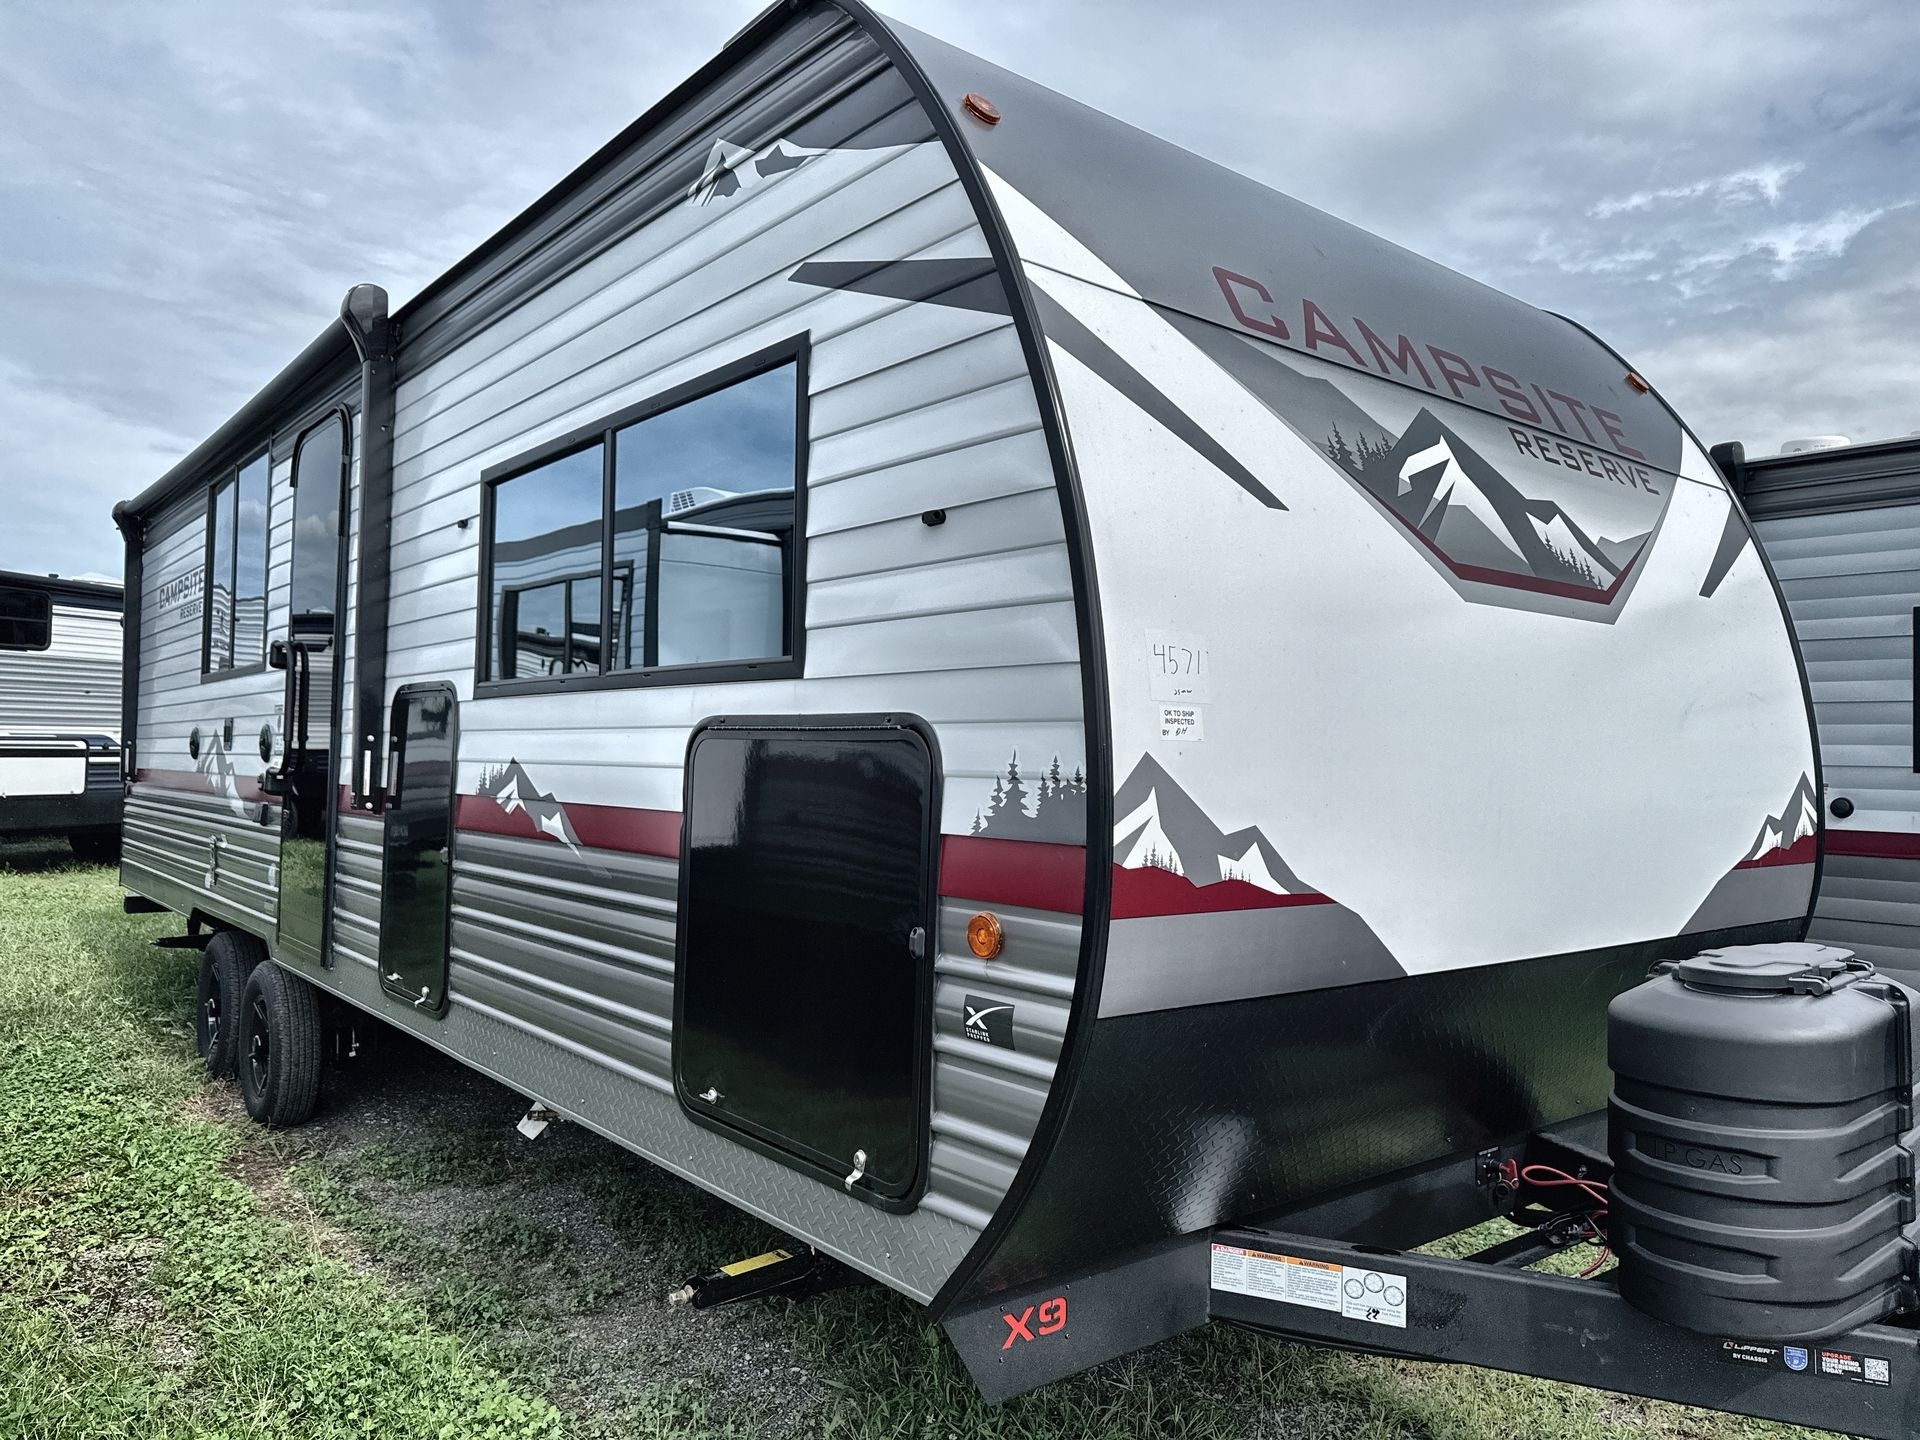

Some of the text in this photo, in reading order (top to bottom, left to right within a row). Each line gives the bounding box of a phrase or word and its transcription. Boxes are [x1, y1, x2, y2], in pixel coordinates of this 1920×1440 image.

[1212, 266, 1647, 461] CAMPSITE
[1508, 427, 1661, 496] RESERVE
[159, 568, 205, 610] CAMPSITE
[180, 601, 203, 619] RESERVE
[1153, 643, 1201, 675] 4571
[1163, 709, 1173, 717] OK
[1182, 710, 1194, 718] SHIP
[1164, 718, 1195, 726] INSPECTED
[1653, 1139, 1743, 1176] LP GAS
[1256, 1251, 1282, 1262] WARNING
[1303, 1260, 1330, 1270] WARNING
[1002, 1296, 1068, 1350] X9
[1734, 1343, 1779, 1355] LIPPERT
[1821, 1351, 1852, 1361] UPGRADE
[1732, 1352, 1768, 1364] RV CHASSIS
